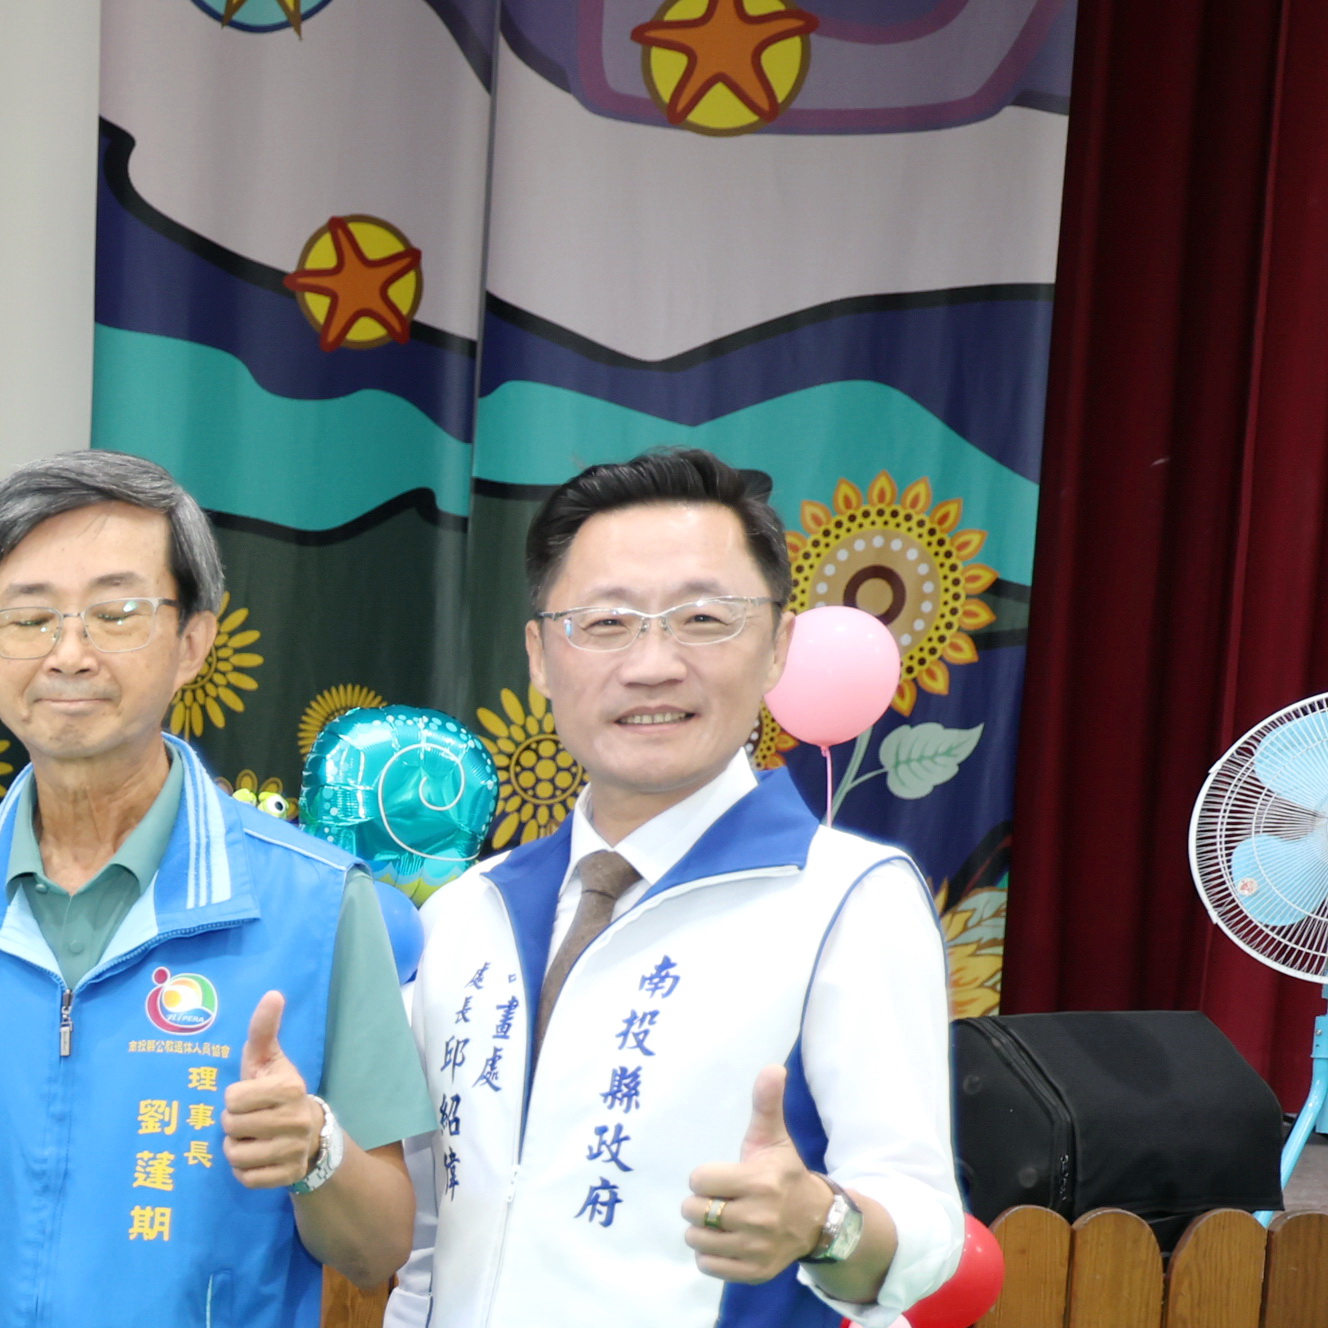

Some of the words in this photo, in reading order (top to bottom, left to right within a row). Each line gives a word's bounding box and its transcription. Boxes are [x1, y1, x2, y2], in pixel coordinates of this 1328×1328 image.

[183, 1066, 218, 1168] 理事長
[574, 955, 680, 1229] 南投縣政府
[129, 1098, 179, 1242] 劉蓬期
